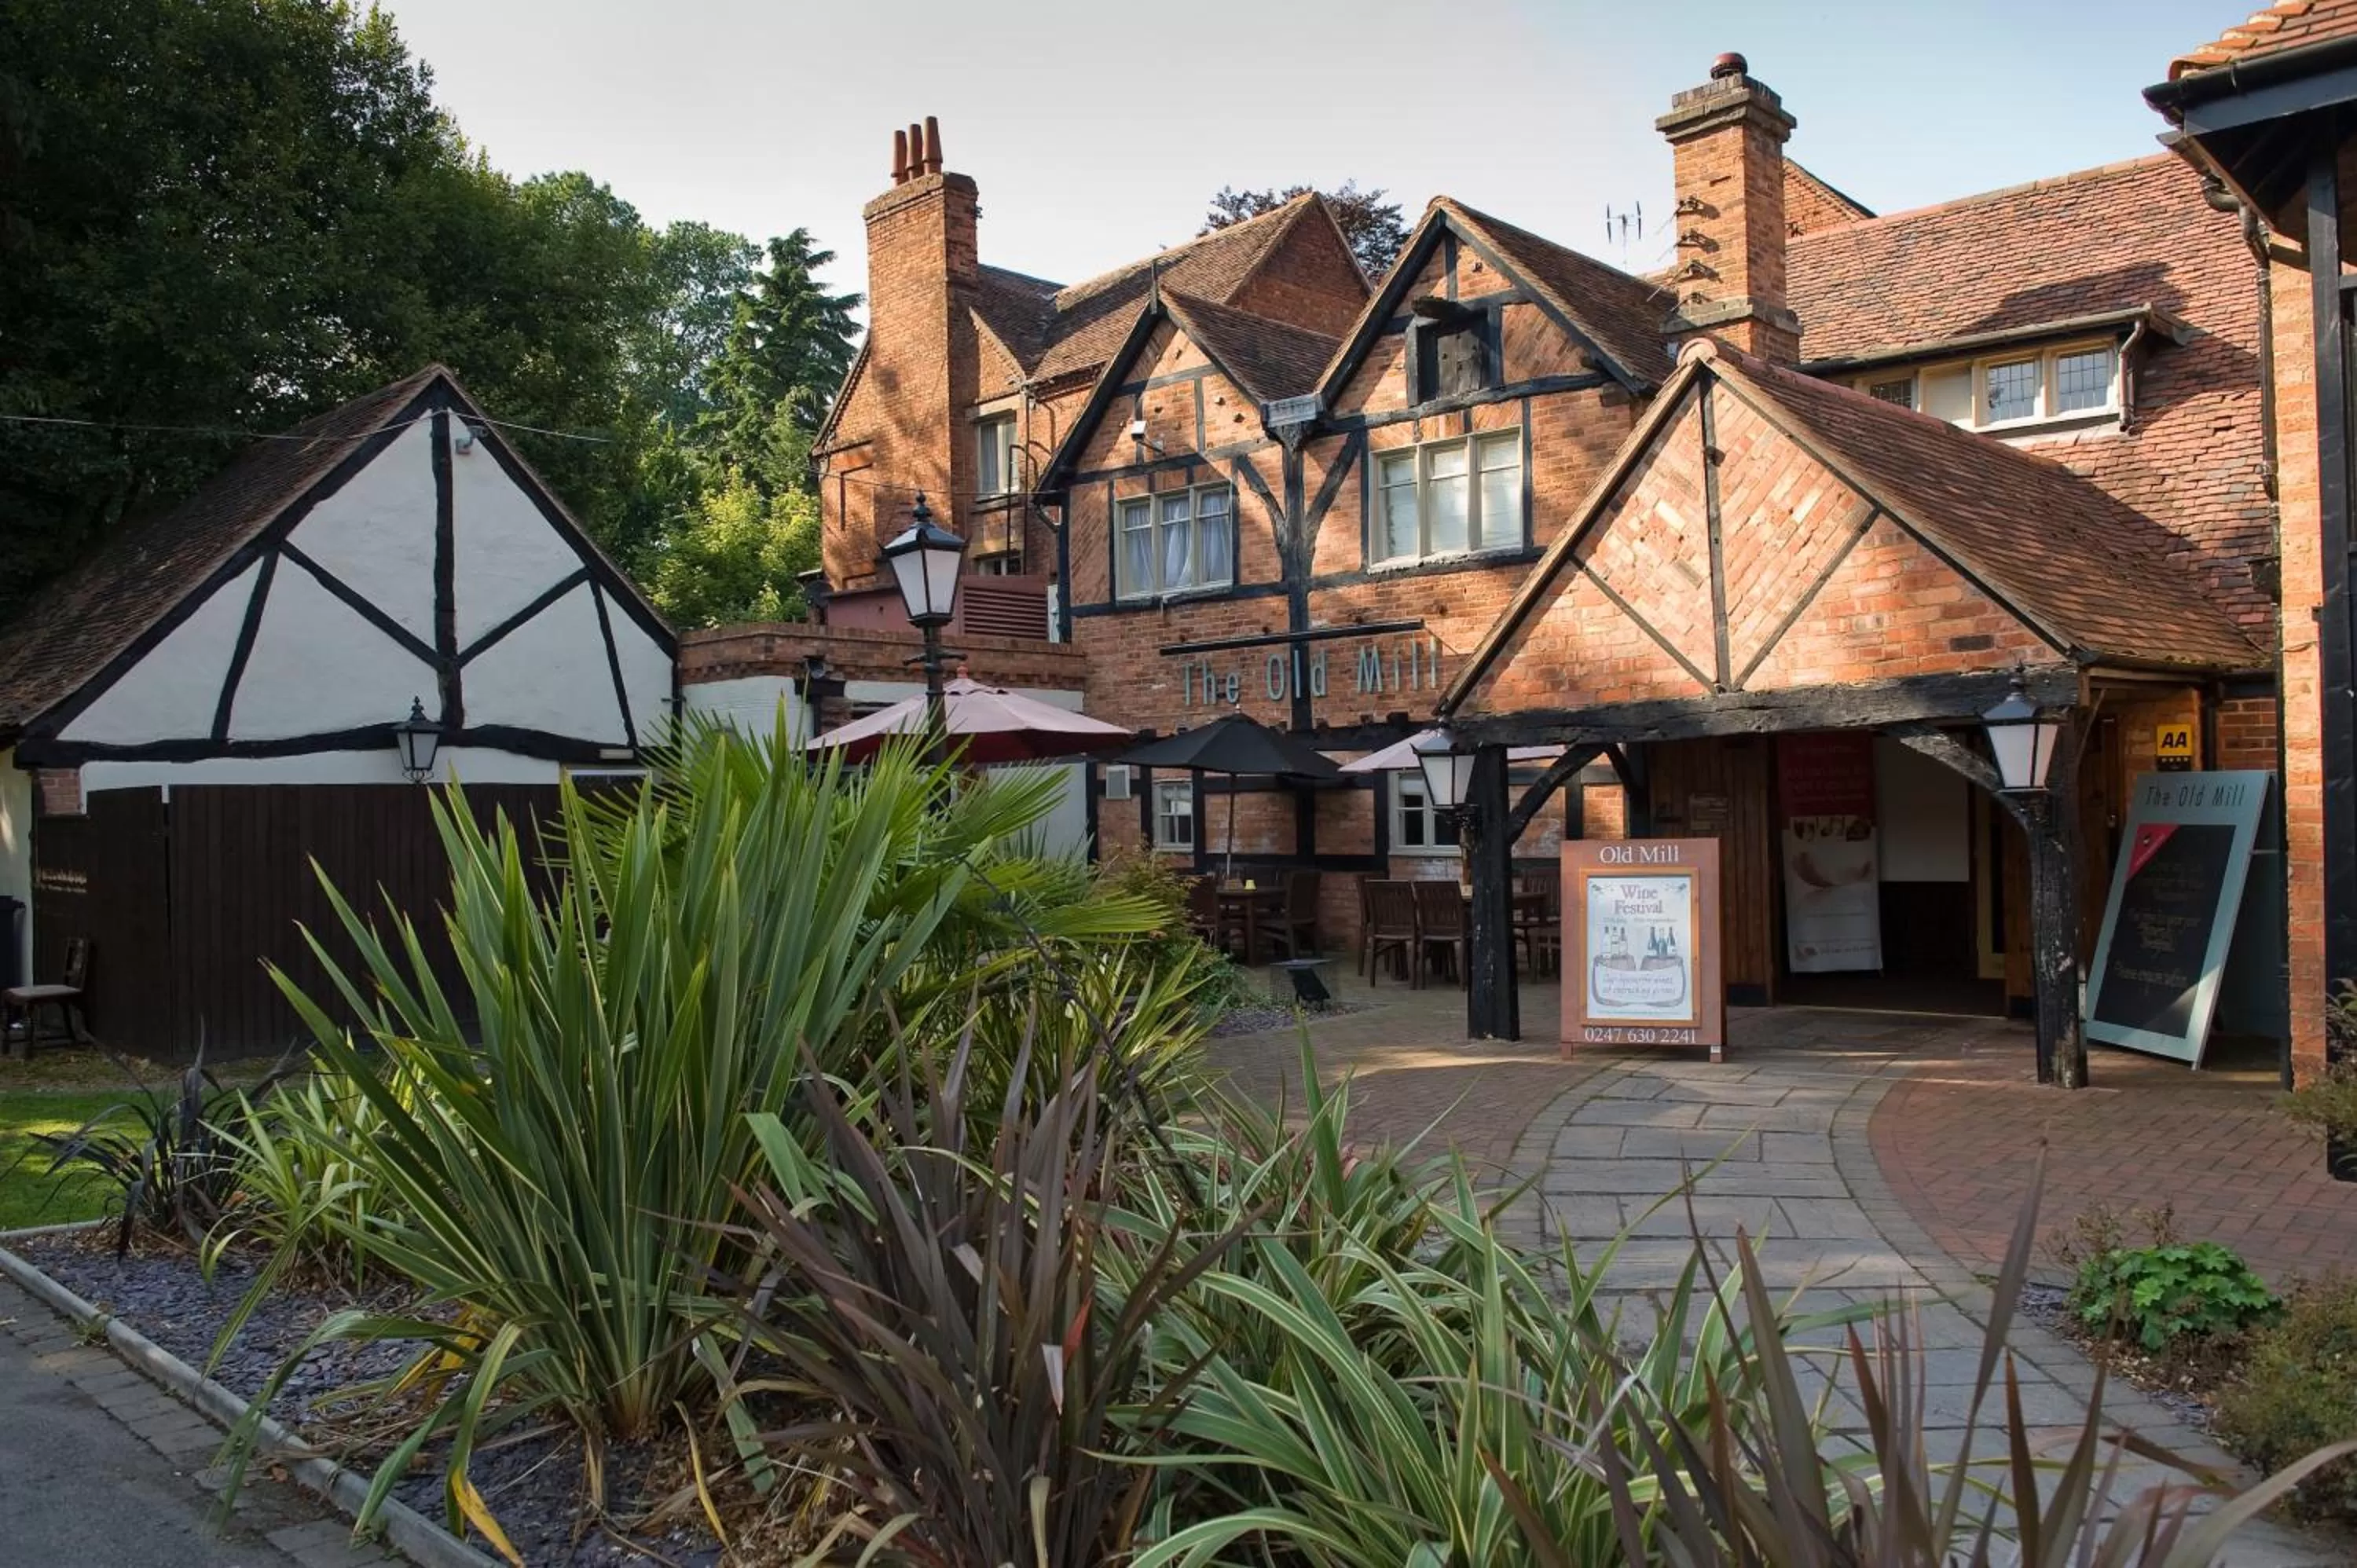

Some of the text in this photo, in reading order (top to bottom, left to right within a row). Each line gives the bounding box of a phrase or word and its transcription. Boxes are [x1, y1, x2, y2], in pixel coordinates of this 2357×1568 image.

[1182, 634, 1439, 706] The Old Mill
[2161, 731, 2188, 749] AA
[2146, 784, 2245, 807] The Old Mill
[1599, 844, 1680, 864] Old Mill
[1619, 884, 1659, 900] Wine
[1614, 899, 1664, 915] Festival
[1585, 1028, 1697, 1044] 0247 630 2241
